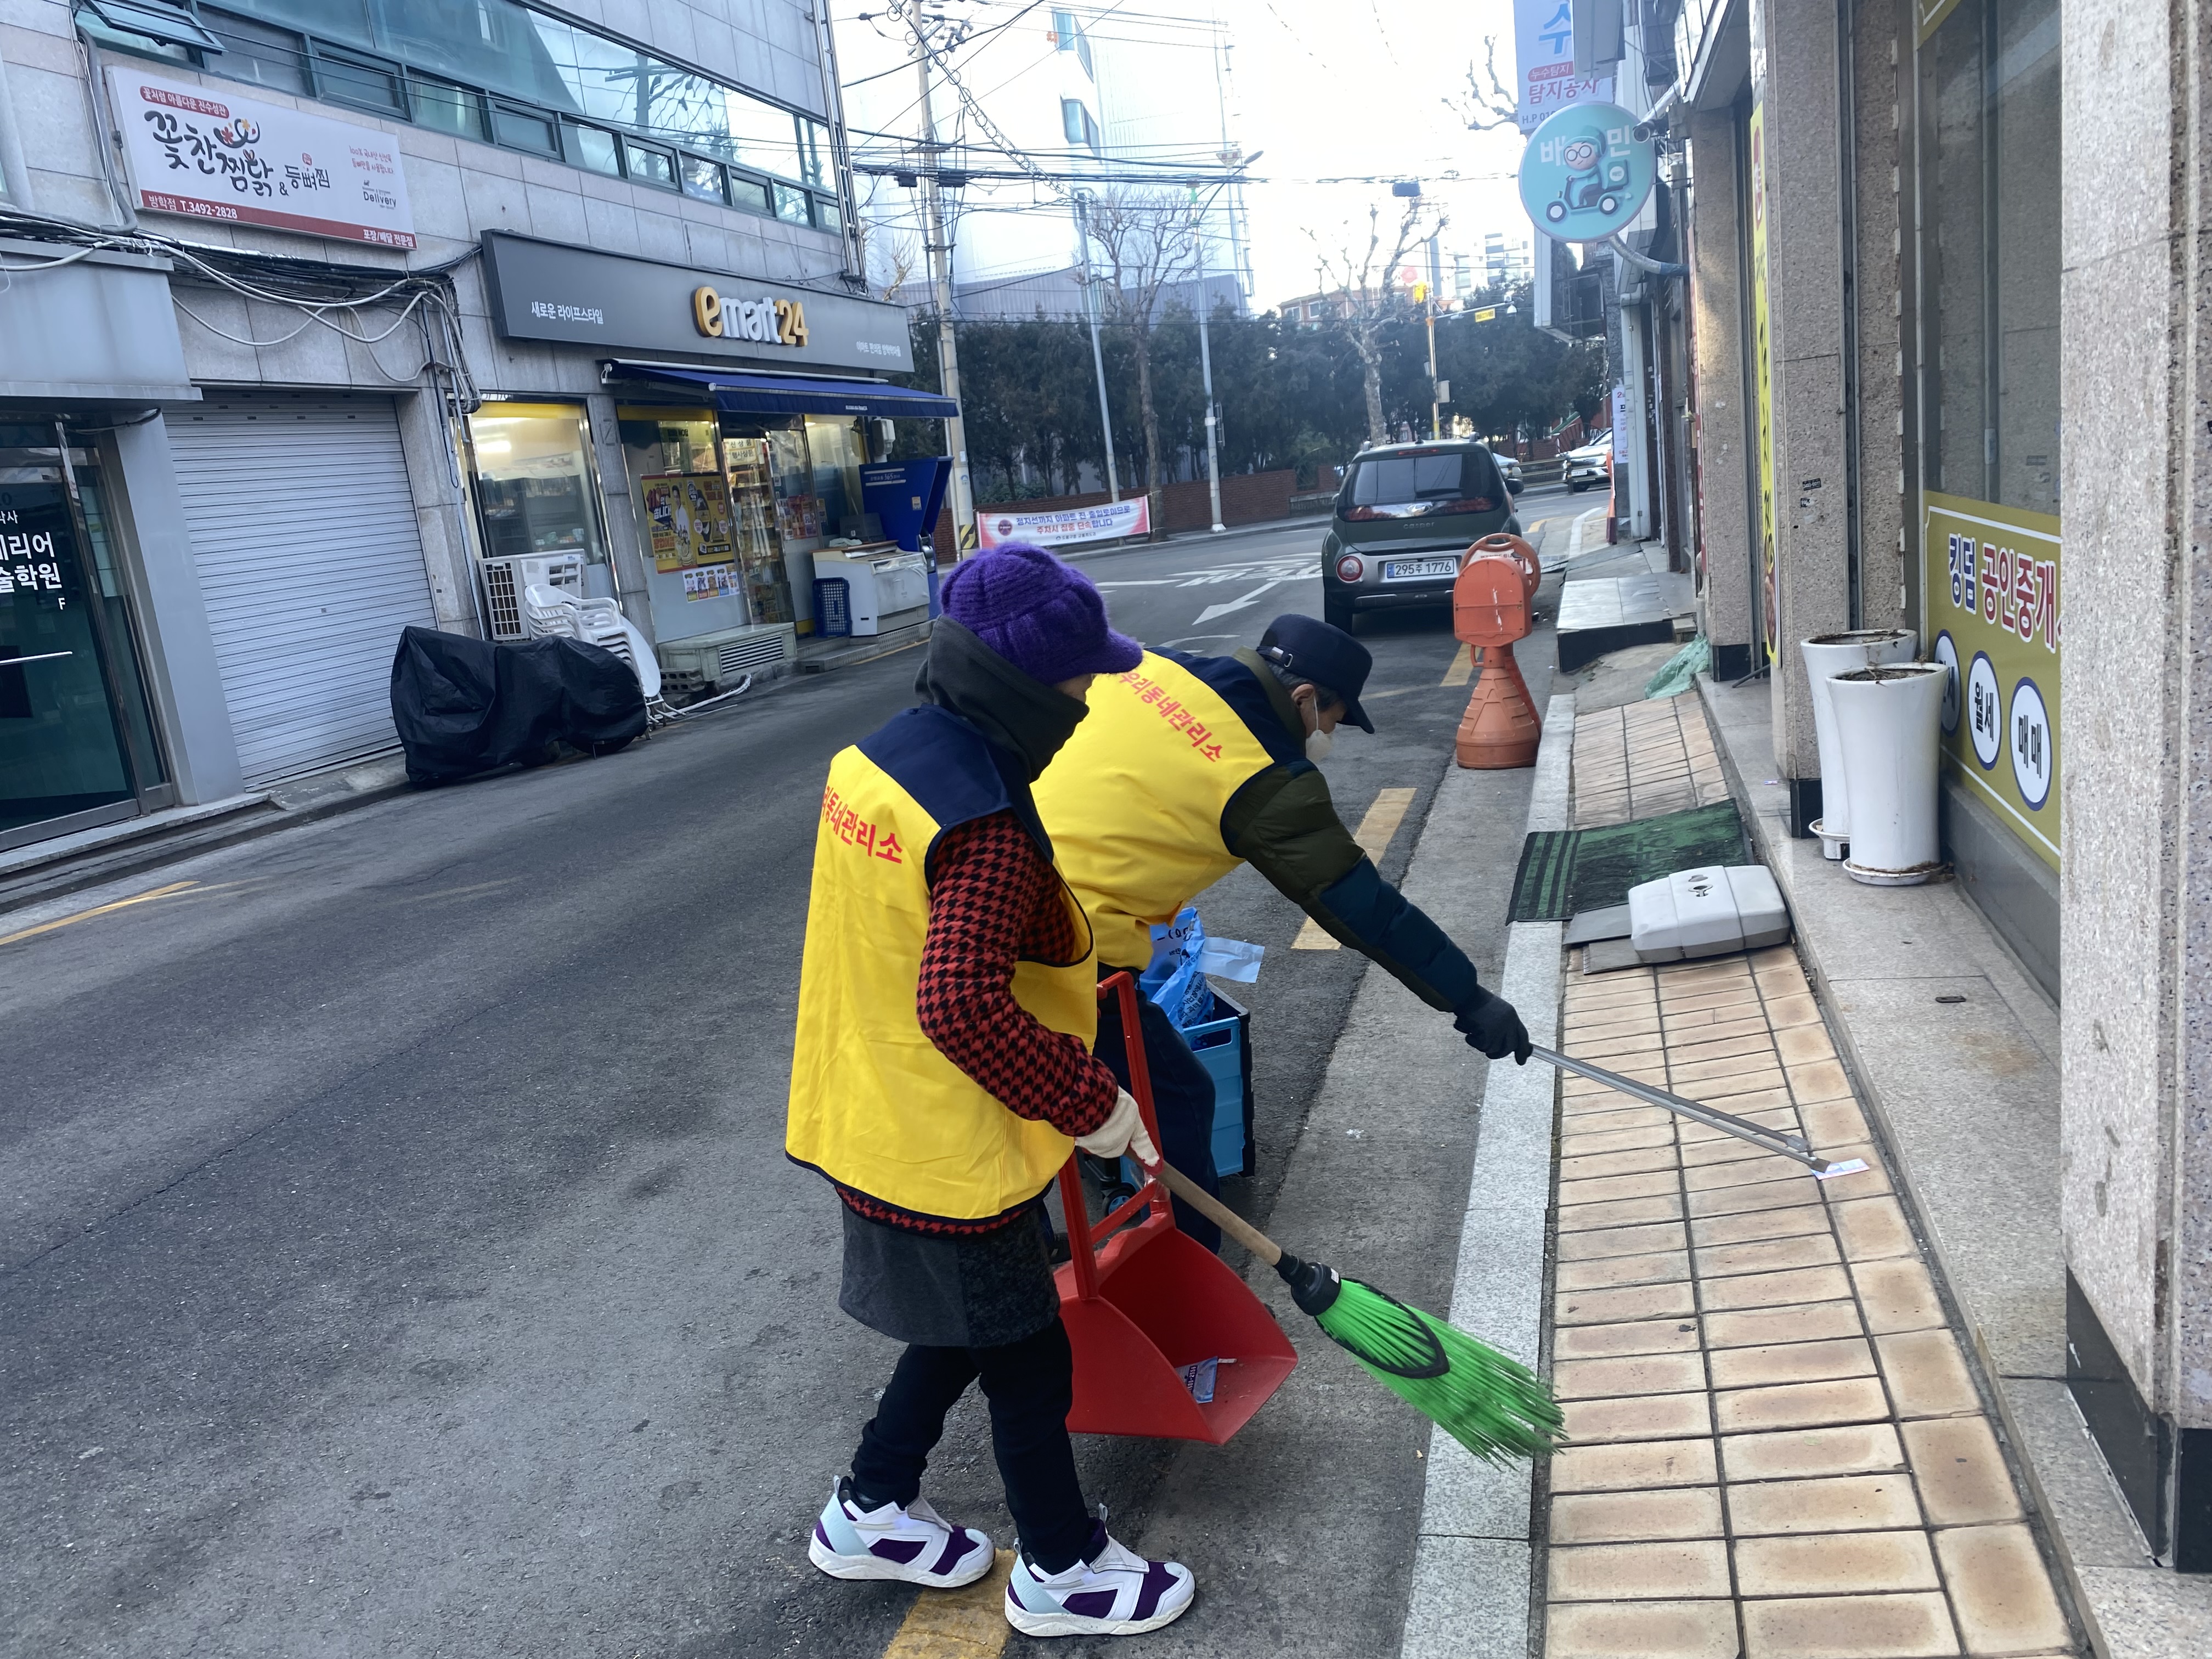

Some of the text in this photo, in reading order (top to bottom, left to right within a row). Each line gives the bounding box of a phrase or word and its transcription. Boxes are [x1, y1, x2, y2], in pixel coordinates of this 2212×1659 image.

[1531, 63, 1569, 79] 누수탐지
[143, 86, 227, 117] 꽃처럼 아름다운 진수성찬
[1528, 77, 1600, 105] 탐지공사
[1522, 113, 1538, 124] H.P
[148, 195, 238, 219] 방학점 T.3492-2828
[363, 191, 397, 208] Delivery
[393, 233, 414, 247] 전문점
[531, 301, 604, 325] 새로운 라이프스타일
[695, 286, 810, 347] emart24
[1016, 515, 1053, 526] 정지선까지
[1056, 513, 1077, 523] 아파트
[1036, 518, 1113, 534] 주차시 집중 단속합니다
[1395, 561, 1451, 575] 295주 1776
[1949, 533, 2061, 654] 킹덤 공인중개
[1119, 672, 1223, 763] 우리동네관리소
[1974, 681, 1994, 742] 월세
[2018, 714, 2042, 779] 매매
